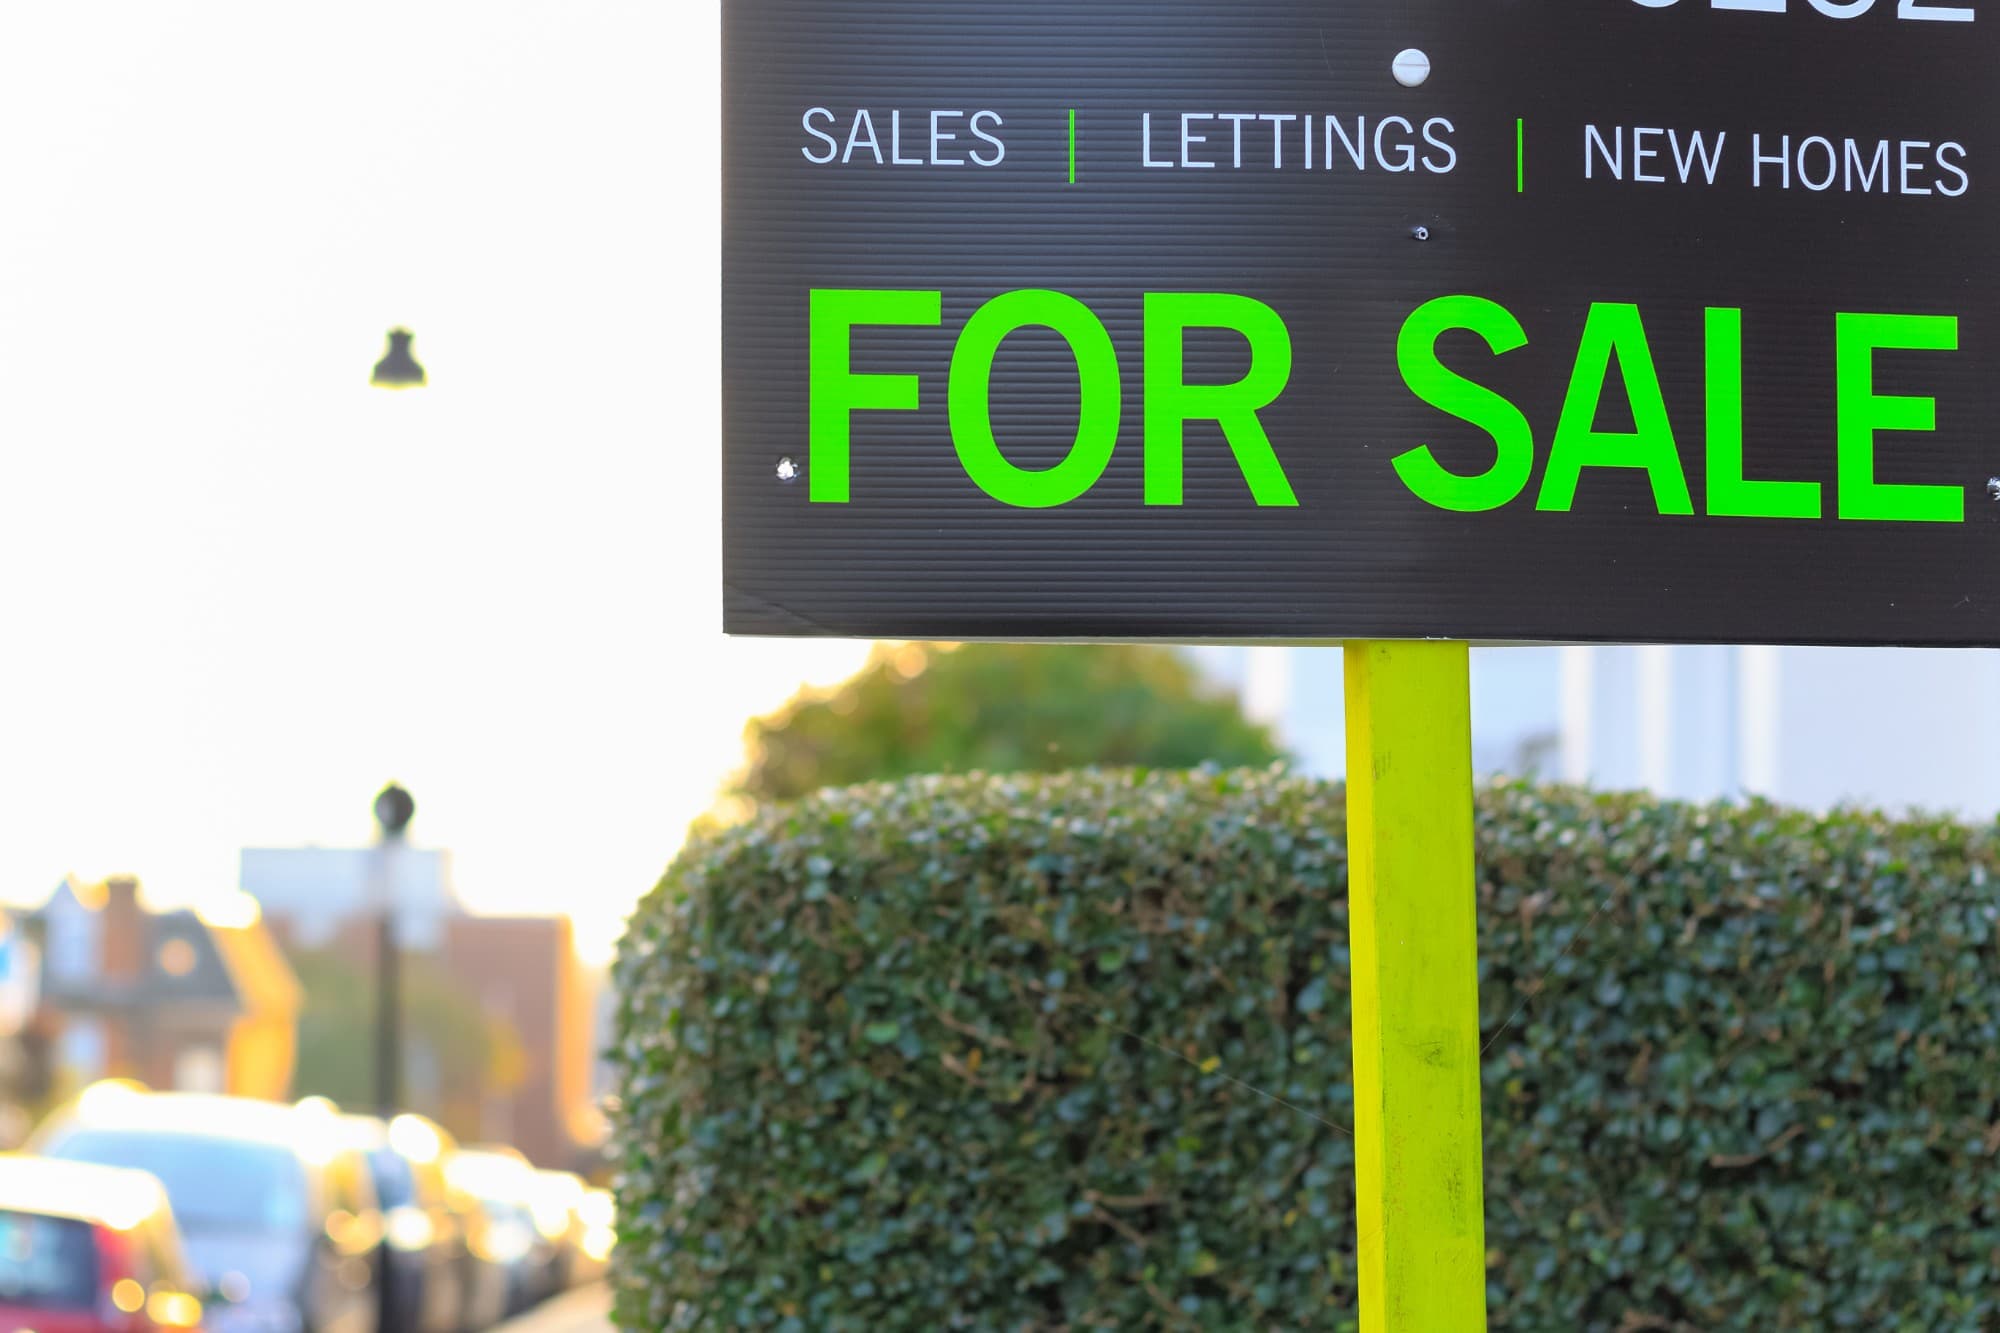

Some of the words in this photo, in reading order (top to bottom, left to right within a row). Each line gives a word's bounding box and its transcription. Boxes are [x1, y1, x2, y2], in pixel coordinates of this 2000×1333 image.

[800, 107, 1006, 167] SALES
[1142, 112, 1458, 174] LETTINGS
[1584, 124, 1726, 185] NEW
[1752, 133, 1970, 197] HOMES
[809, 288, 1299, 508] FOR
[1391, 294, 1965, 523] SALE
